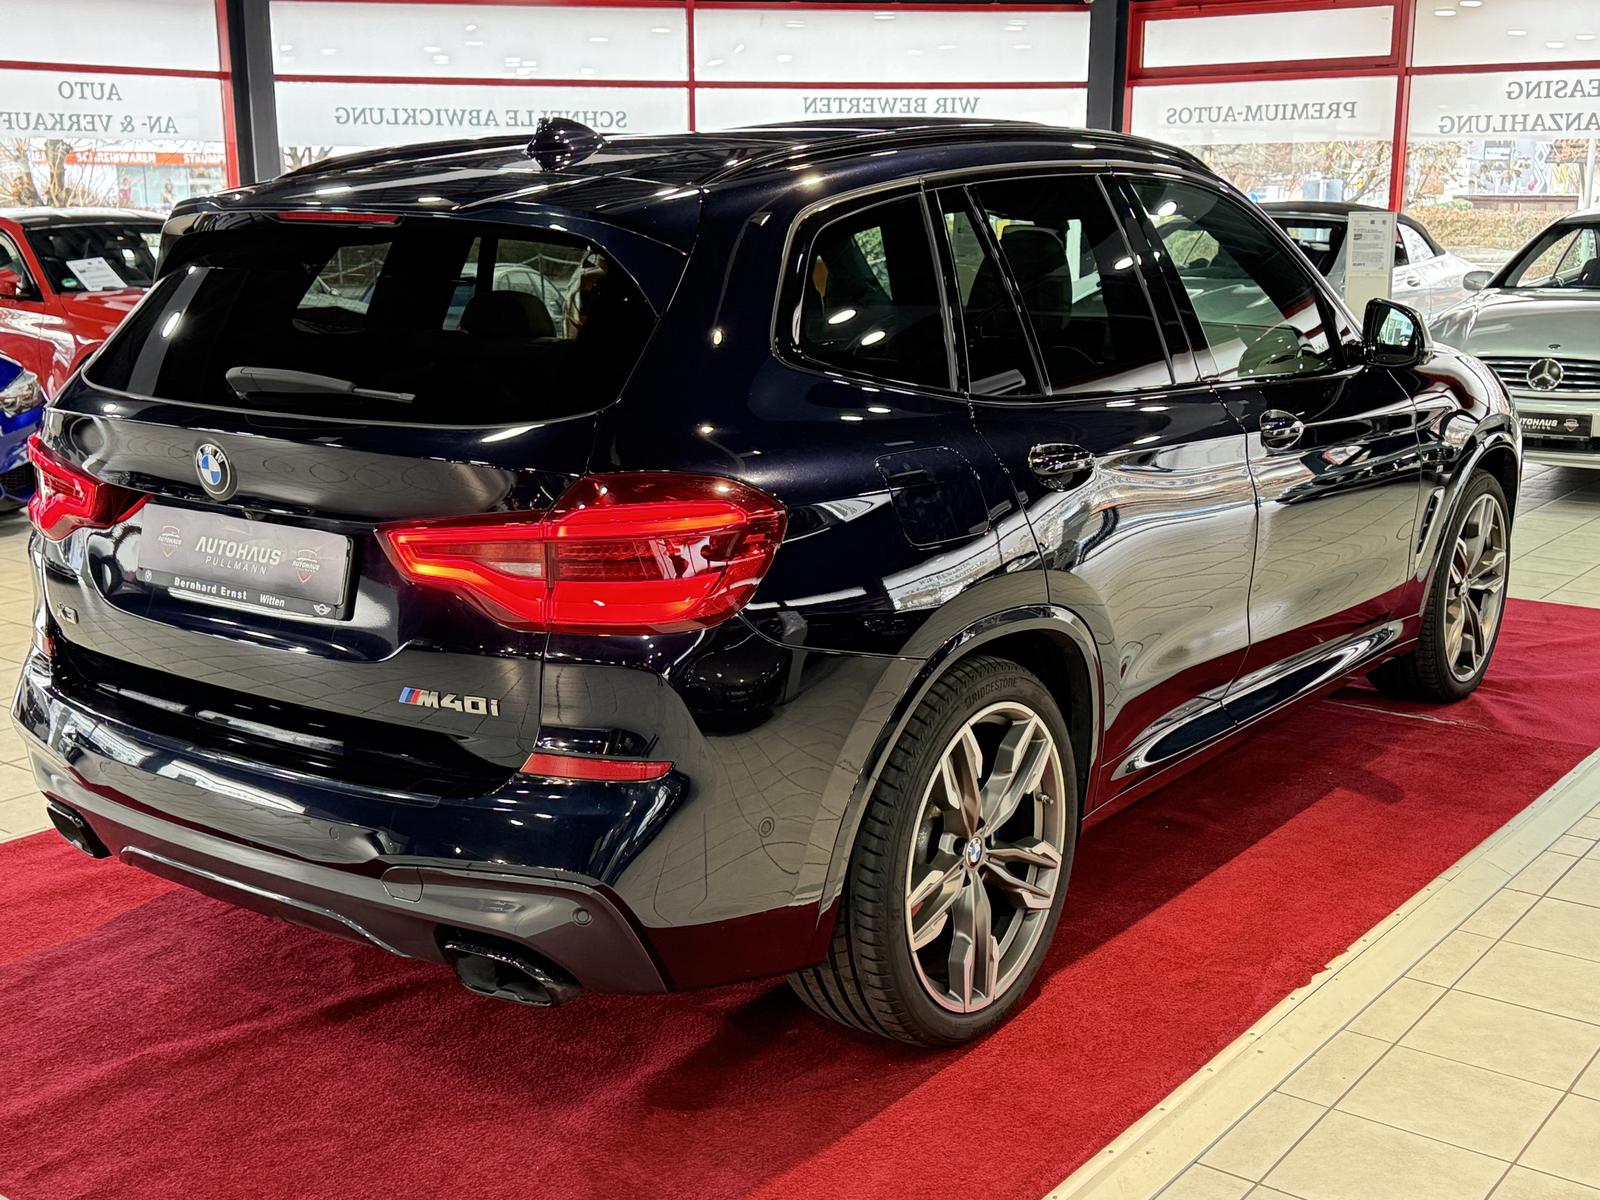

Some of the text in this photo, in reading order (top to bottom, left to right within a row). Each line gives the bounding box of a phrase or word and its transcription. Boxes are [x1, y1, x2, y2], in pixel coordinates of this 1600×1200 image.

[194, 535, 283, 567] AUTOHAUS
[205, 555, 267, 576] PULLMANN
[174, 576, 286, 608] Bernhard Ernst Witten
[416, 689, 499, 717] M40i
